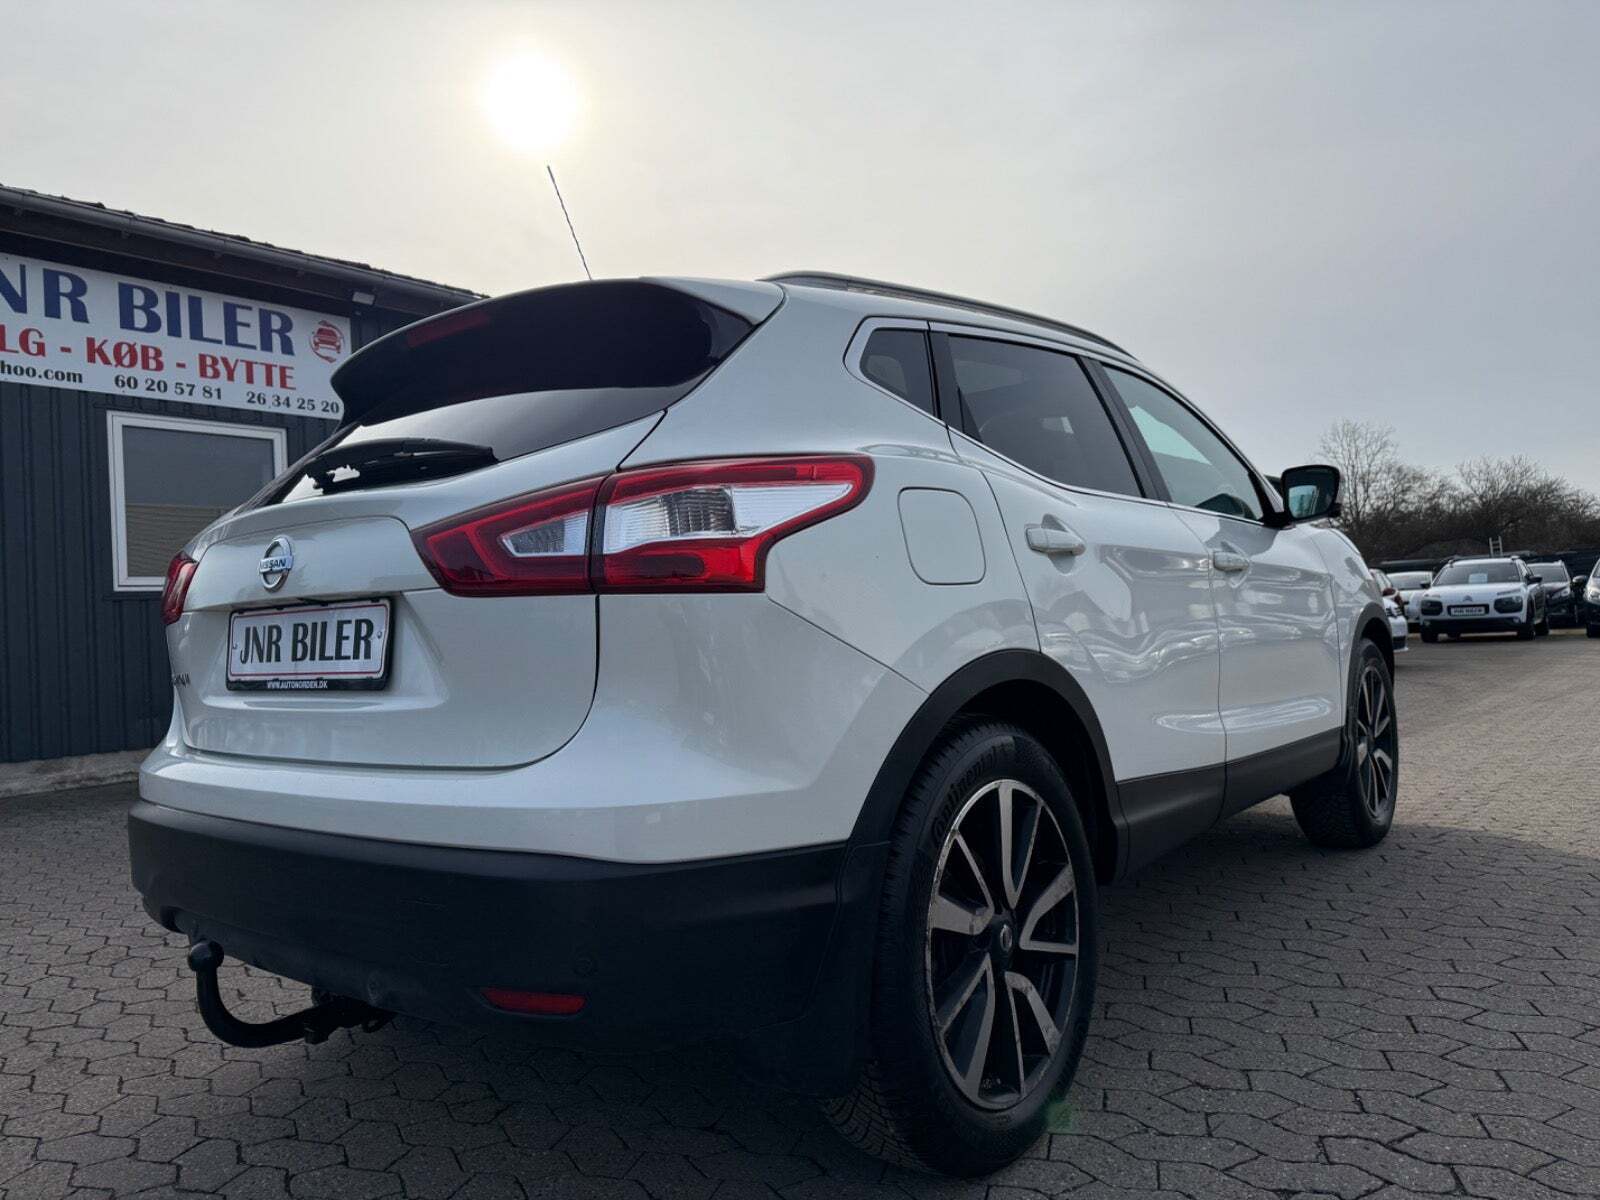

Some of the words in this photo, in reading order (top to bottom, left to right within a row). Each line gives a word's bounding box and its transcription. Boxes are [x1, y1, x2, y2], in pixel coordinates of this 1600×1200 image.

[117, 282, 296, 356] BILER
[86, 337, 164, 372] KØB
[198, 353, 296, 390] BYTTE
[114, 375, 138, 389] 60
[145, 378, 168, 393] 20
[174, 382, 196, 396] 57
[202, 386, 222, 400] 81
[246, 391, 266, 405] 26
[271, 394, 291, 408] 34
[297, 397, 316, 411] 25
[321, 400, 340, 414] 20
[240, 625, 282, 664] JNR
[291, 619, 374, 662] BILER
